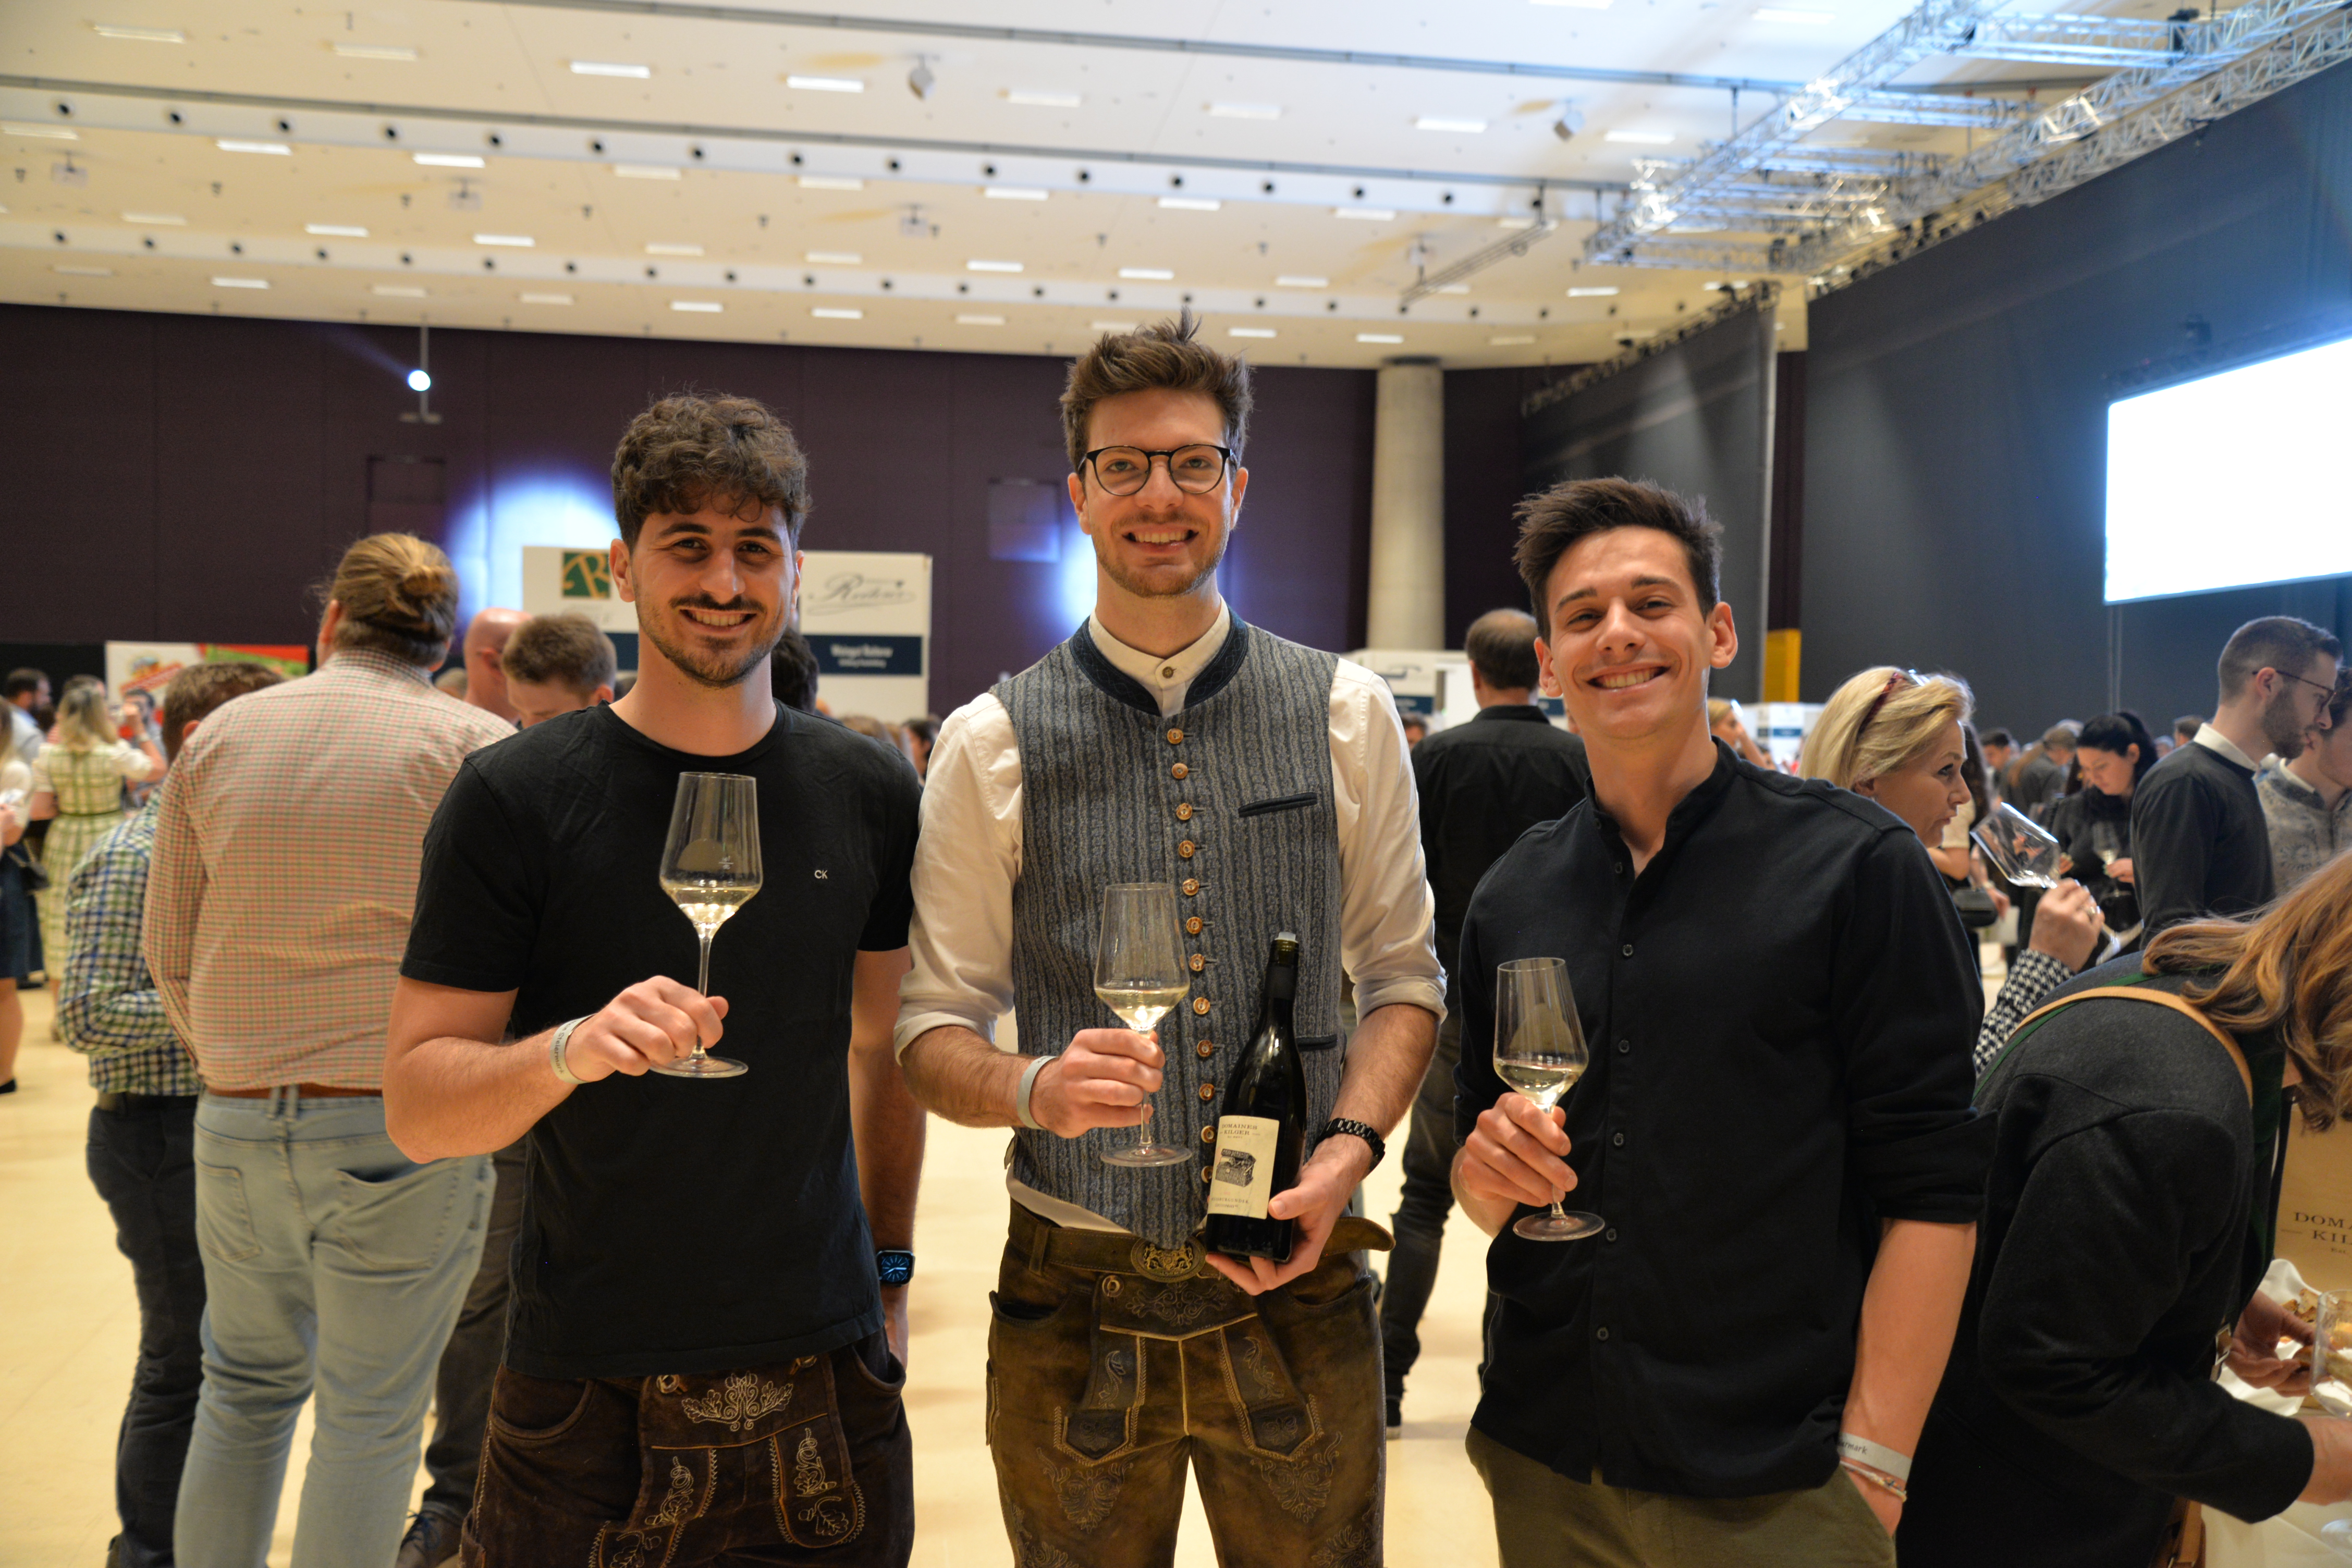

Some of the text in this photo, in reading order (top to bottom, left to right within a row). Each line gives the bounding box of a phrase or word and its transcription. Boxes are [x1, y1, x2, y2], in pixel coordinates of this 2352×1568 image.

[814, 869, 828, 879] CK
[554, 1032, 565, 1074] Steiermark
[2295, 1212, 2352, 1230] DOM
